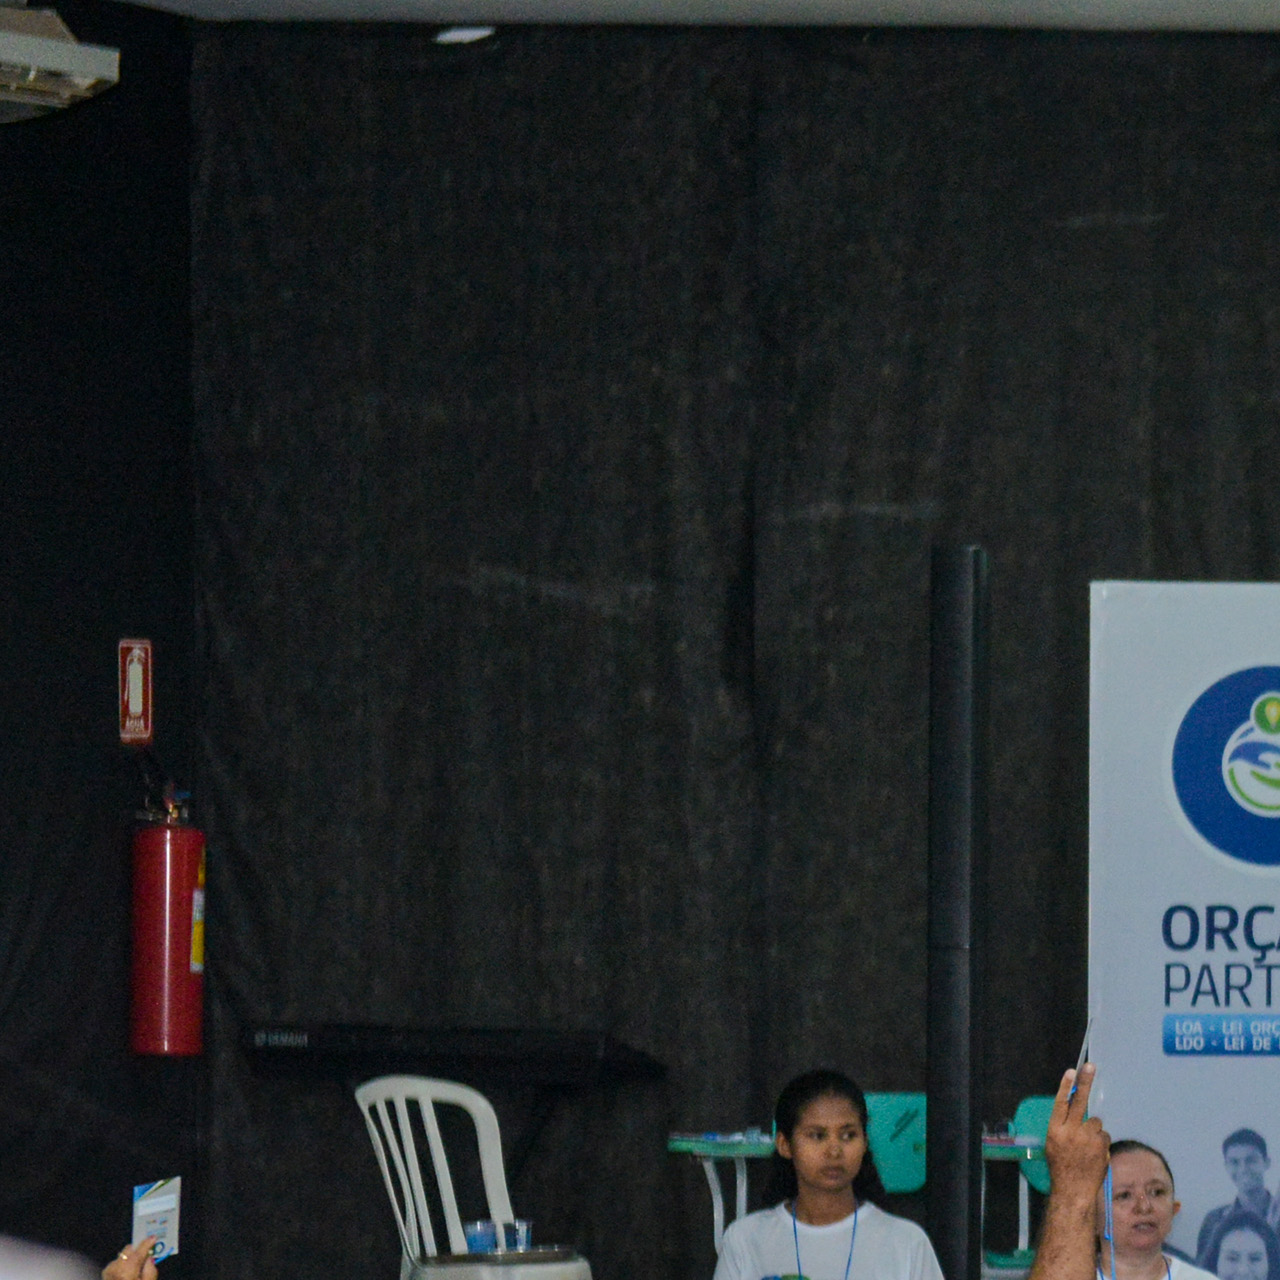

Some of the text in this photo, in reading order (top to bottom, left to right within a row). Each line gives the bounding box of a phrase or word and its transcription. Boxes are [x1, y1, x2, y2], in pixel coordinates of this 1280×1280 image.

[1175, 1021, 1203, 1036] LOA
[1222, 1021, 1243, 1036] LEI
[1175, 1037, 1205, 1052] LDO
[1224, 1037, 1245, 1052] LEI
[1253, 1037, 1272, 1051] DE
